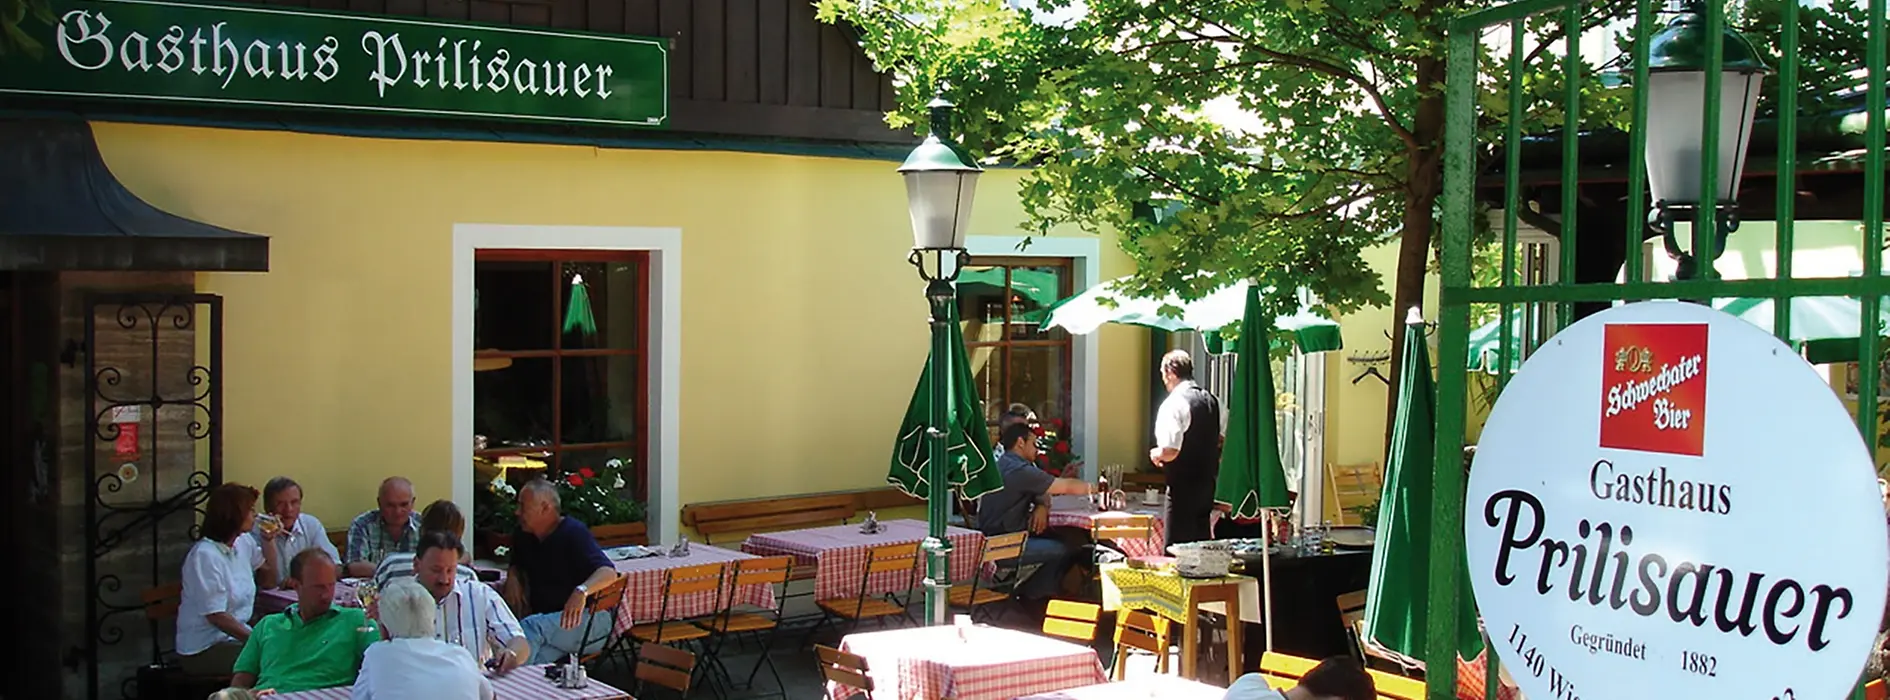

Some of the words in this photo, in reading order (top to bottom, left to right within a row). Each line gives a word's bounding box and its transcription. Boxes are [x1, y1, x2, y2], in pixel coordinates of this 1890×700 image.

[56, 9, 340, 90] Gasthaus
[361, 30, 613, 100] Prilisauer
[1605, 353, 1702, 418] Schwechater
[1652, 397, 1692, 430] Bier
[1590, 459, 1732, 515] Gasthaus
[1484, 489, 1853, 652] Prilisauer
[1508, 622, 1545, 678] 1140
[1548, 666, 1581, 700] Wi
[1570, 624, 1646, 660] Gegründet
[1681, 649, 1718, 678] 1882
